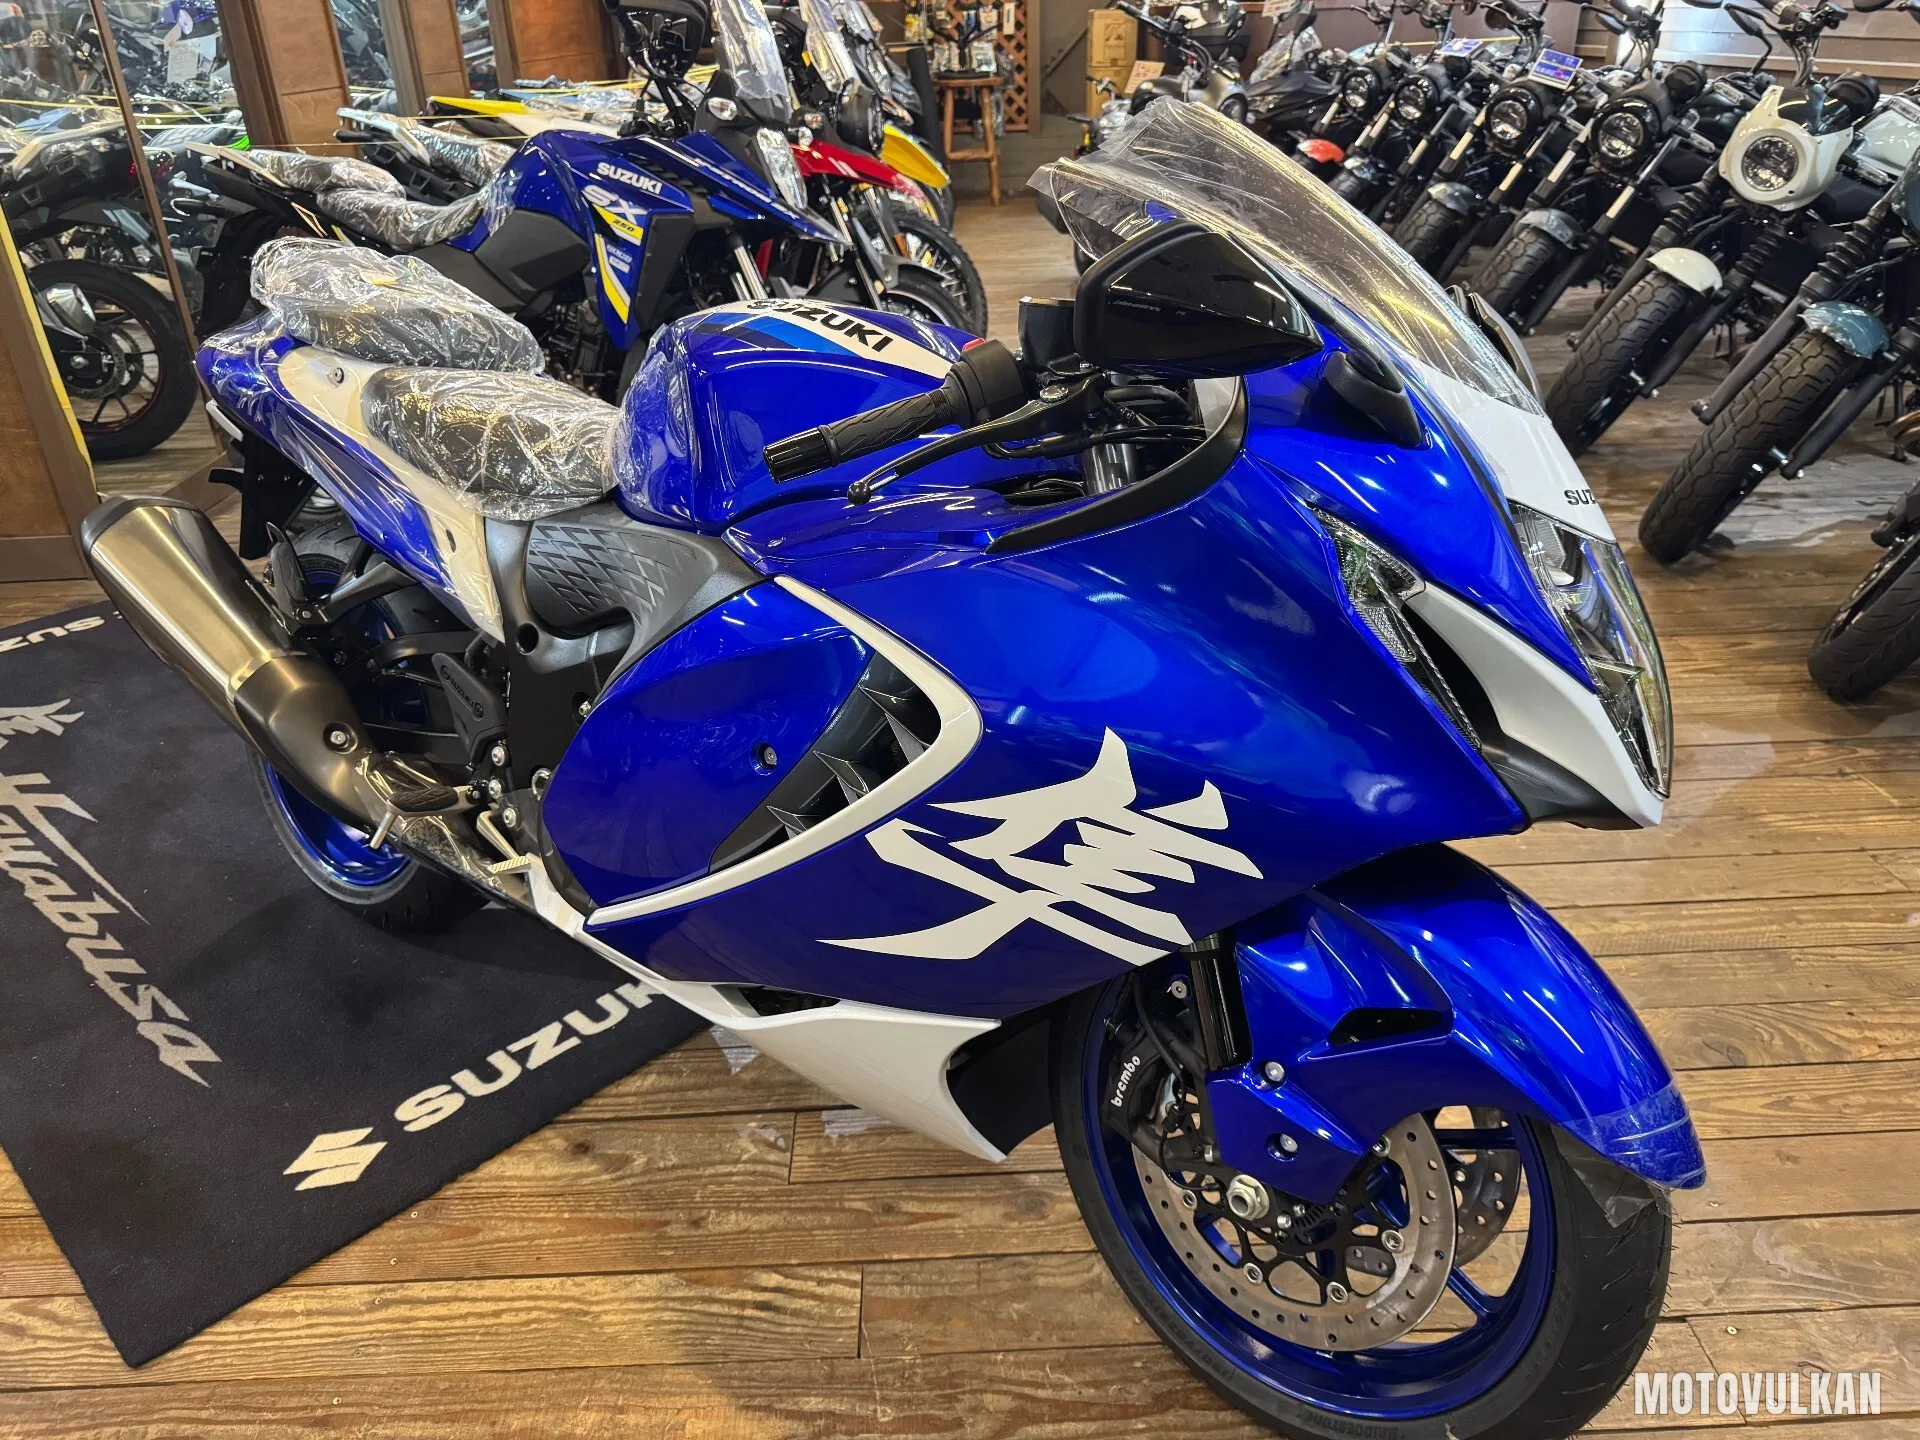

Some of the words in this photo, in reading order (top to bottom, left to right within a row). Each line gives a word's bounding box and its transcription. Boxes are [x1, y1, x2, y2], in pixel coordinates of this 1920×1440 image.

[596, 161, 663, 195] SUZUKI
[581, 184, 648, 226] SX
[611, 218, 635, 233] 250
[746, 299, 894, 353] SUZUKI
[1110, 1055, 1141, 1107] brembo
